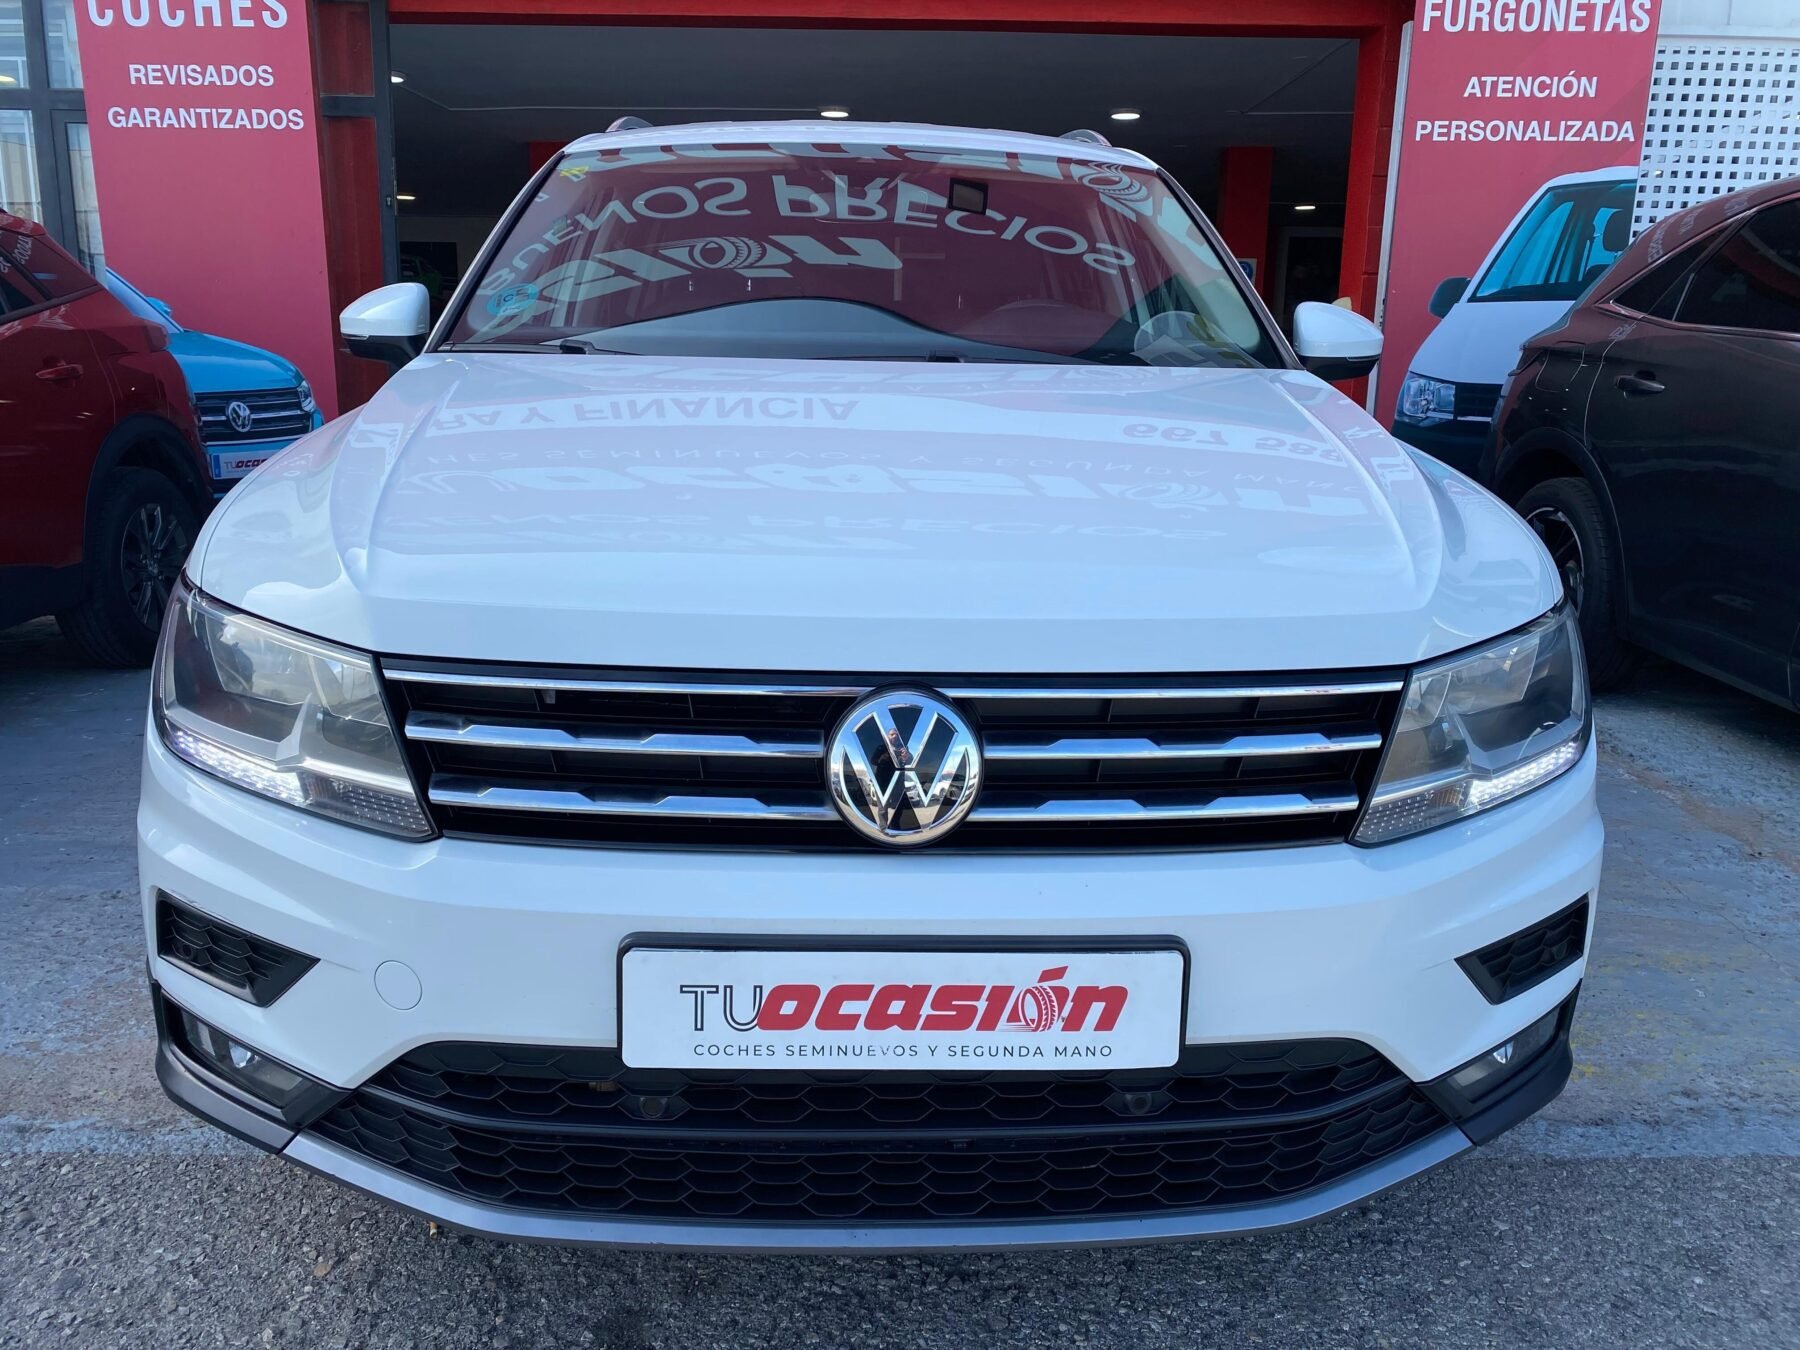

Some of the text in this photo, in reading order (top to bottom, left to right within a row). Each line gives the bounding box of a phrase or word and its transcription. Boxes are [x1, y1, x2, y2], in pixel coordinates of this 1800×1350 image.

[87, 0, 288, 28] COCHES
[1422, 0, 1653, 32] FURGONETAS
[128, 64, 275, 87] REVISADOS
[1463, 70, 1598, 98] ATENCIÓN
[107, 106, 305, 130] GARANTIZADOS
[1415, 119, 1636, 142] PERSONALIZADA
[693, 1044, 1112, 1058] COCHES SEMINUEVOS Y SEGUNDA MANO
